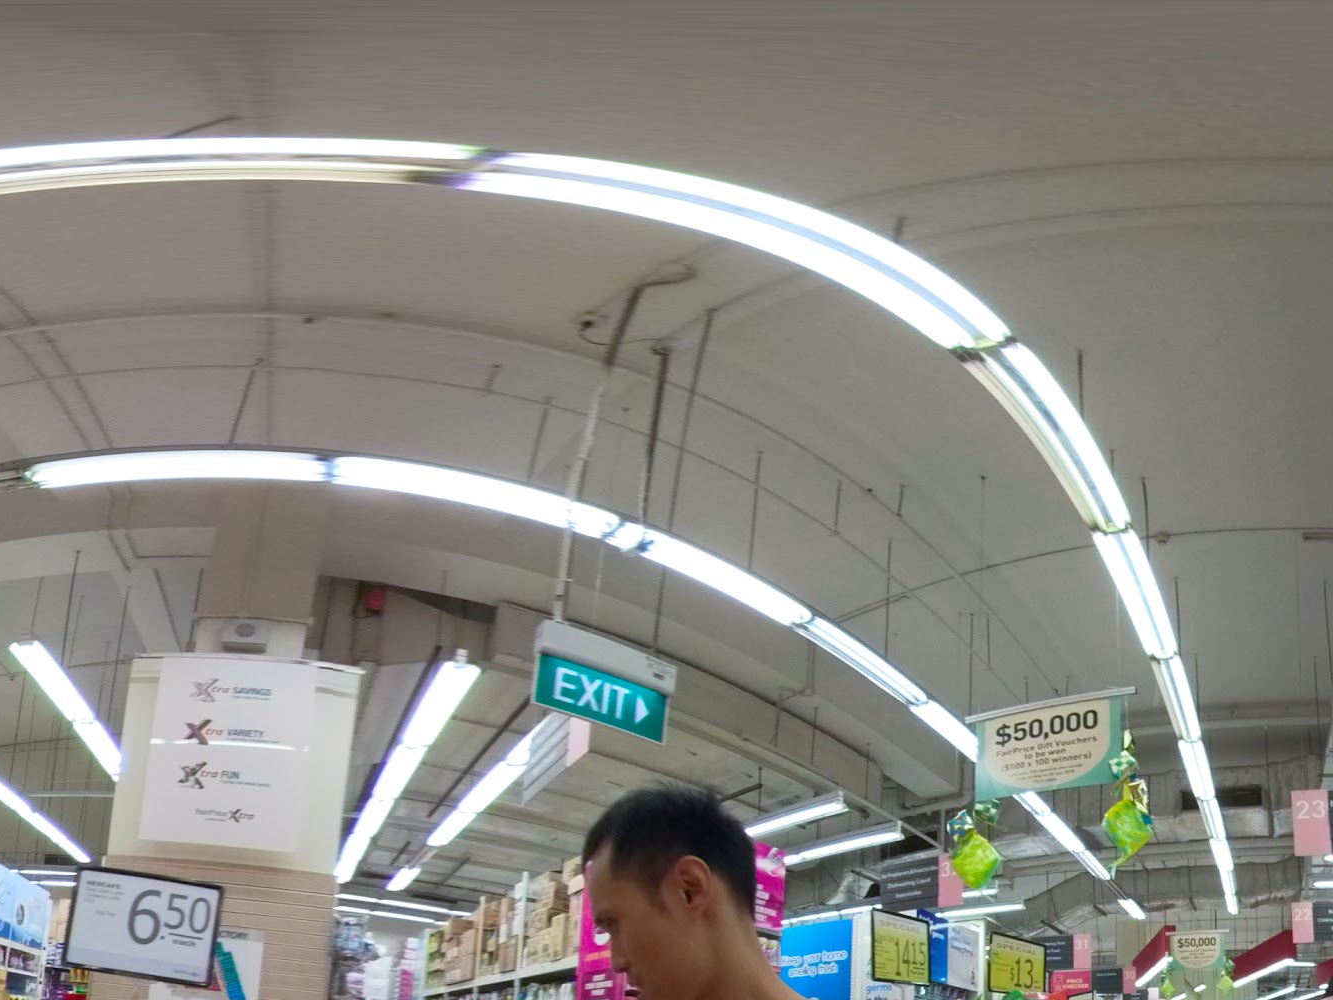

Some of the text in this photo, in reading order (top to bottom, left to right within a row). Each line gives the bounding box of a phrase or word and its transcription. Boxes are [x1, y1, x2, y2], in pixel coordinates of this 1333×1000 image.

[233, 687, 272, 696] SAVINGS
[552, 665, 630, 721] EXIT
[183, 719, 265, 745] Xtra VARIETY
[995, 710, 1098, 747] $50,000
[996, 736, 1097, 757] FairPrice Gift Vouchers
[1035, 758, 1049, 766] 100
[221, 771, 239, 779] FUN
[195, 808, 254, 823] FairPrice Xtra
[1296, 800, 1326, 819] 23
[86, 880, 121, 890] NESCAFE
[887, 877, 931, 889] Dishwashing Liquid
[128, 889, 211, 945] 6.50
[1294, 909, 1312, 921] 22
[879, 920, 921, 934] SPECIAL
[172, 939, 196, 947] each
[996, 943, 1037, 956] SPECIAL
[1075, 940, 1088, 950] 31
[1177, 937, 1216, 949] $50,000
[781, 949, 848, 966] Keep your home
[788, 962, 838, 978] smelling fresh
[1010, 958, 1033, 989] $13
[866, 984, 892, 996] germs
